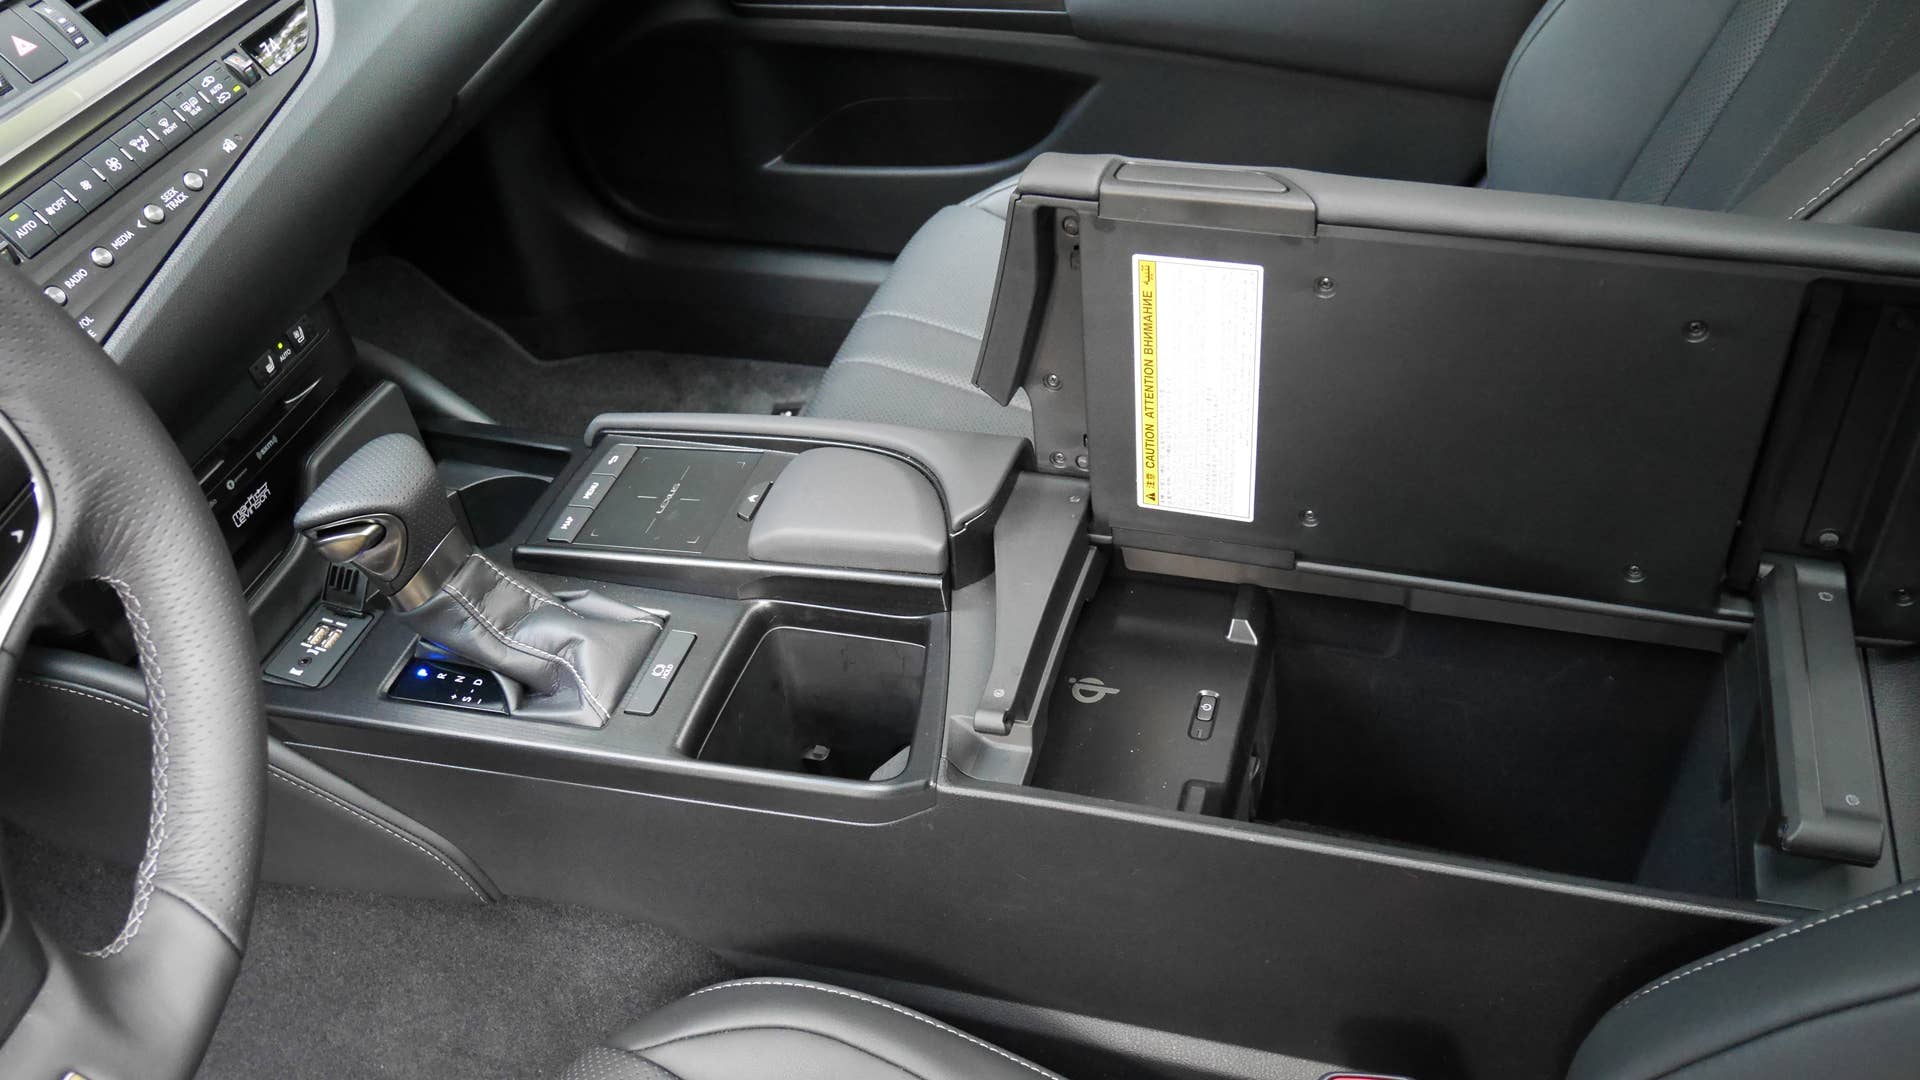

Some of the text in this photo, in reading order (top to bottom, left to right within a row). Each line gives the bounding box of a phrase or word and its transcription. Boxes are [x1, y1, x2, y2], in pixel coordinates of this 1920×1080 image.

[52, 196, 68, 212] OFF
[160, 186, 179, 203] SEEK
[165, 192, 189, 211] TRACK
[15, 220, 38, 239] AUTO
[110, 230, 135, 250] MEDIA
[64, 268, 88, 289] RADIO
[1142, 290, 1154, 355] ВНИМАНИЕ
[279, 348, 292, 363] AUTO
[1143, 359, 1155, 469] CAUTION ATTENTION
[582, 482, 600, 499] MENU
[656, 483, 680, 513] LEXUS
[436, 672, 448, 680] R
[454, 675, 466, 683] N
[472, 678, 483, 686] D
